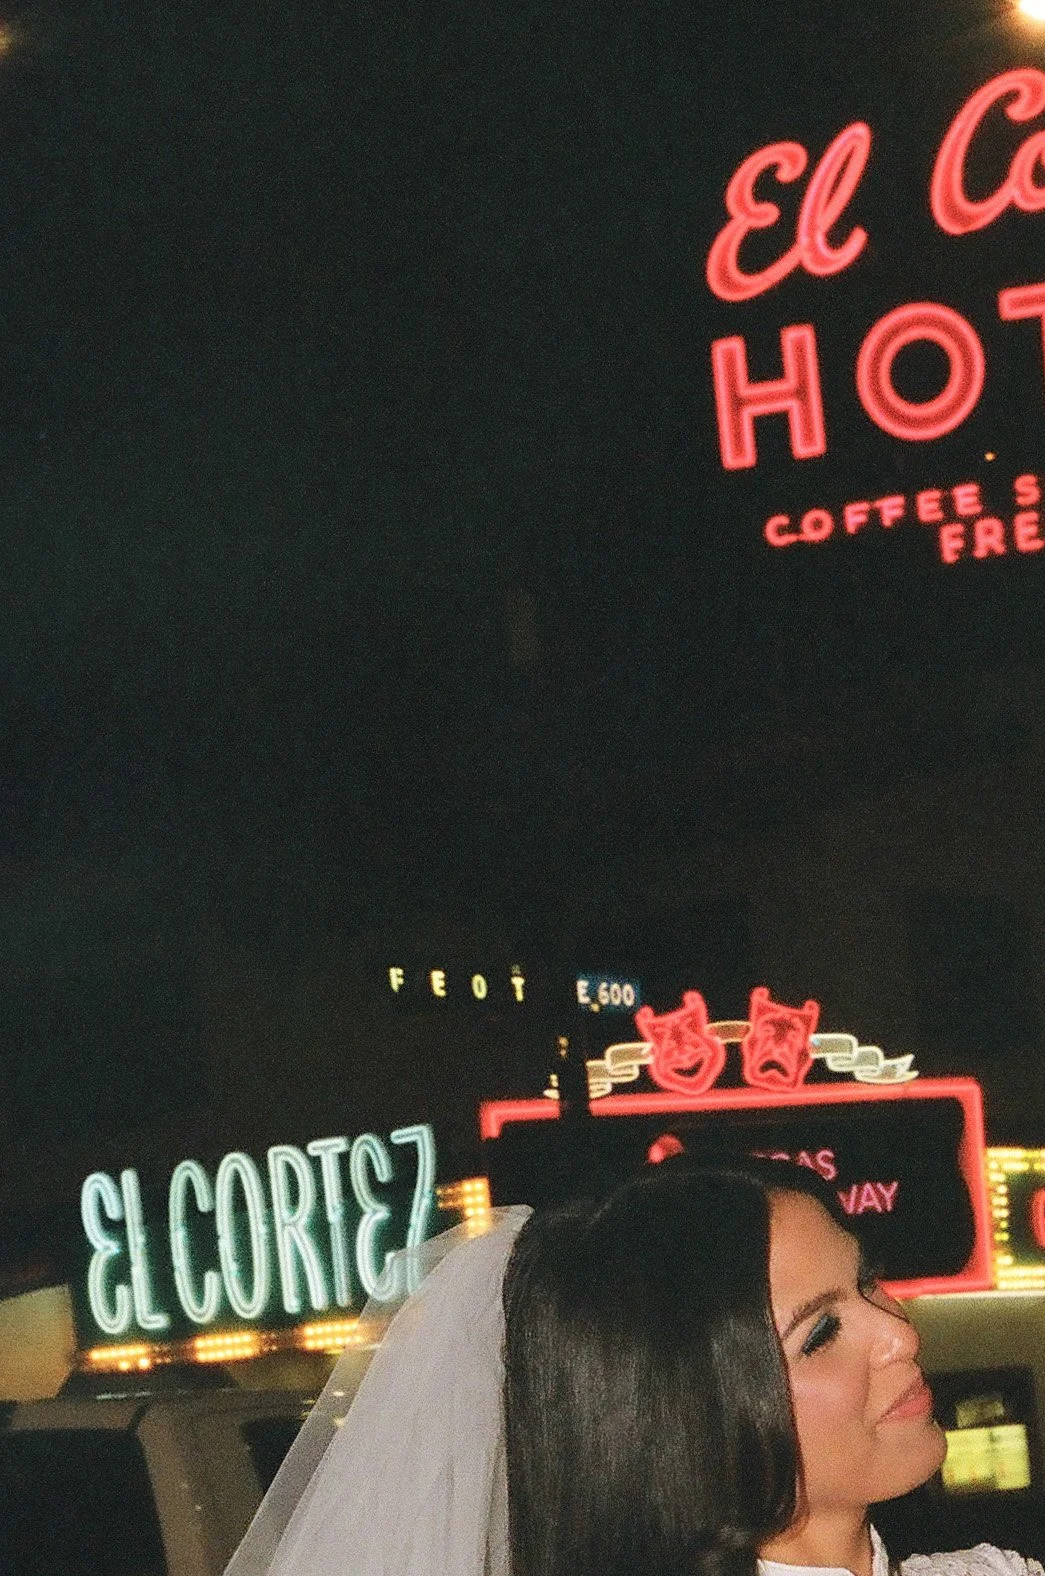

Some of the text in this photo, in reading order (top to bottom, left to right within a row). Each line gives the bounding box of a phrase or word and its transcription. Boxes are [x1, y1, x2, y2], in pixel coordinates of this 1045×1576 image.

[706, 122, 872, 302] El
[765, 482, 983, 548] COFFEE
[81, 1123, 437, 1334] EL CORTEZ
